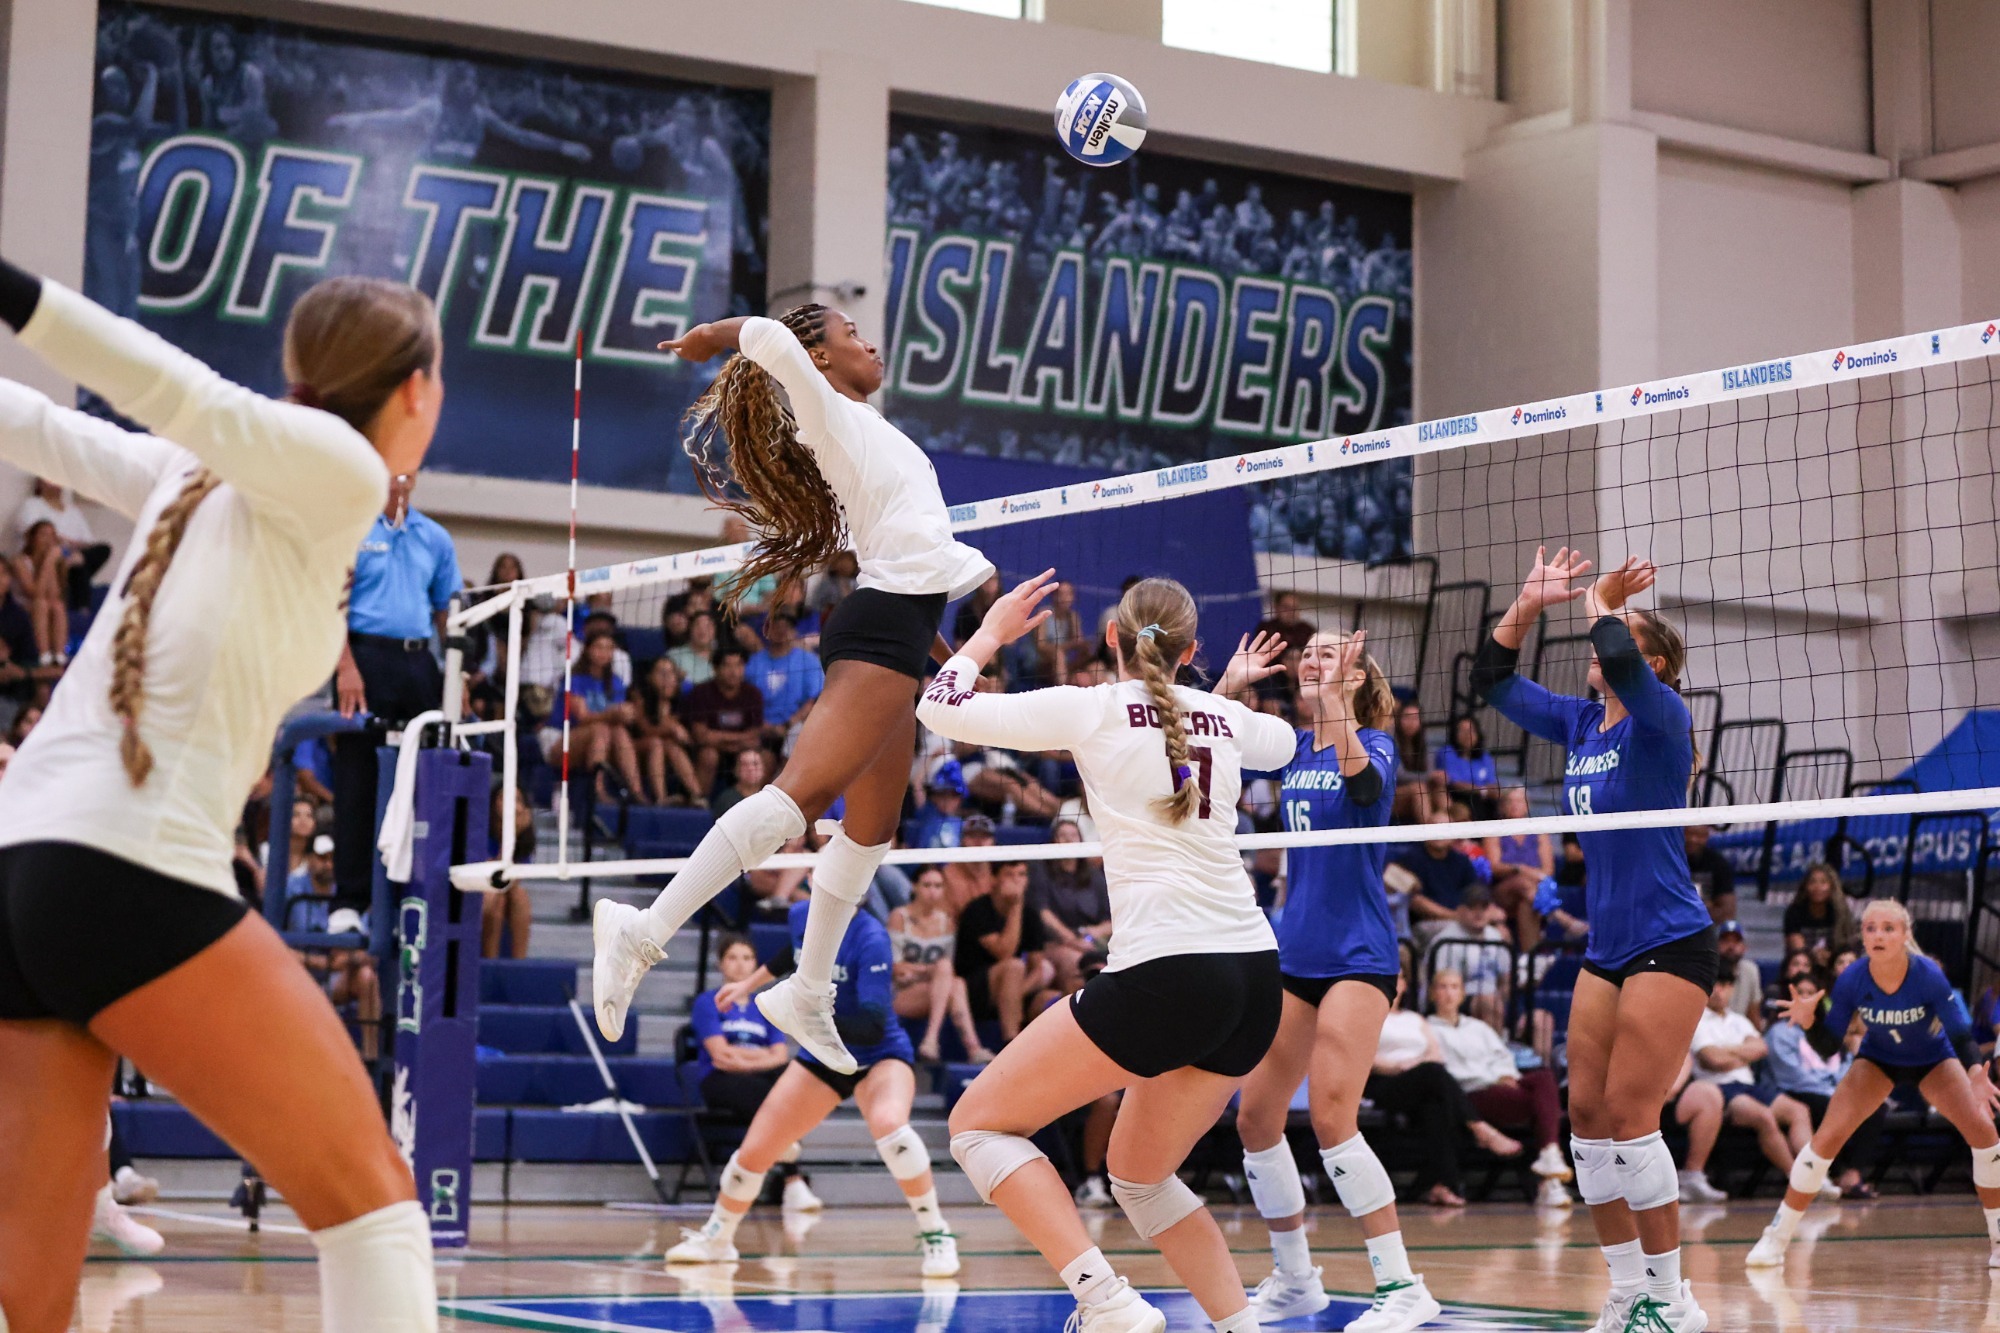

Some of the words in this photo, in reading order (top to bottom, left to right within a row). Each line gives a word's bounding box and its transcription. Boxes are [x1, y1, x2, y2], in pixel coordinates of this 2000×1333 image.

[1074, 93, 1103, 138] NCAA
[1088, 99, 1119, 148] molten
[137, 134, 362, 318] OF
[403, 164, 708, 365] THE
[882, 227, 1396, 440] ISLANDERS
[946, 504, 977, 523] NDERS
[1010, 499, 1041, 513] Domino's
[1101, 483, 1133, 498] Domino's
[1157, 464, 1208, 487] ISLANDERS
[1246, 457, 1284, 473] Domino's
[1352, 437, 1391, 454] Domino's
[1418, 416, 1478, 443] ISLANDERS
[1523, 406, 1567, 425] Domino's
[1644, 386, 1689, 405] Domino's
[1721, 360, 1793, 391] ISLANDERS
[1847, 349, 1898, 370] Domino's
[1126, 703, 1234, 738] BOCATS
[1286, 800, 1311, 832] 16
[1568, 785, 1594, 815] 18
[1888, 1028, 1902, 1044] 1
